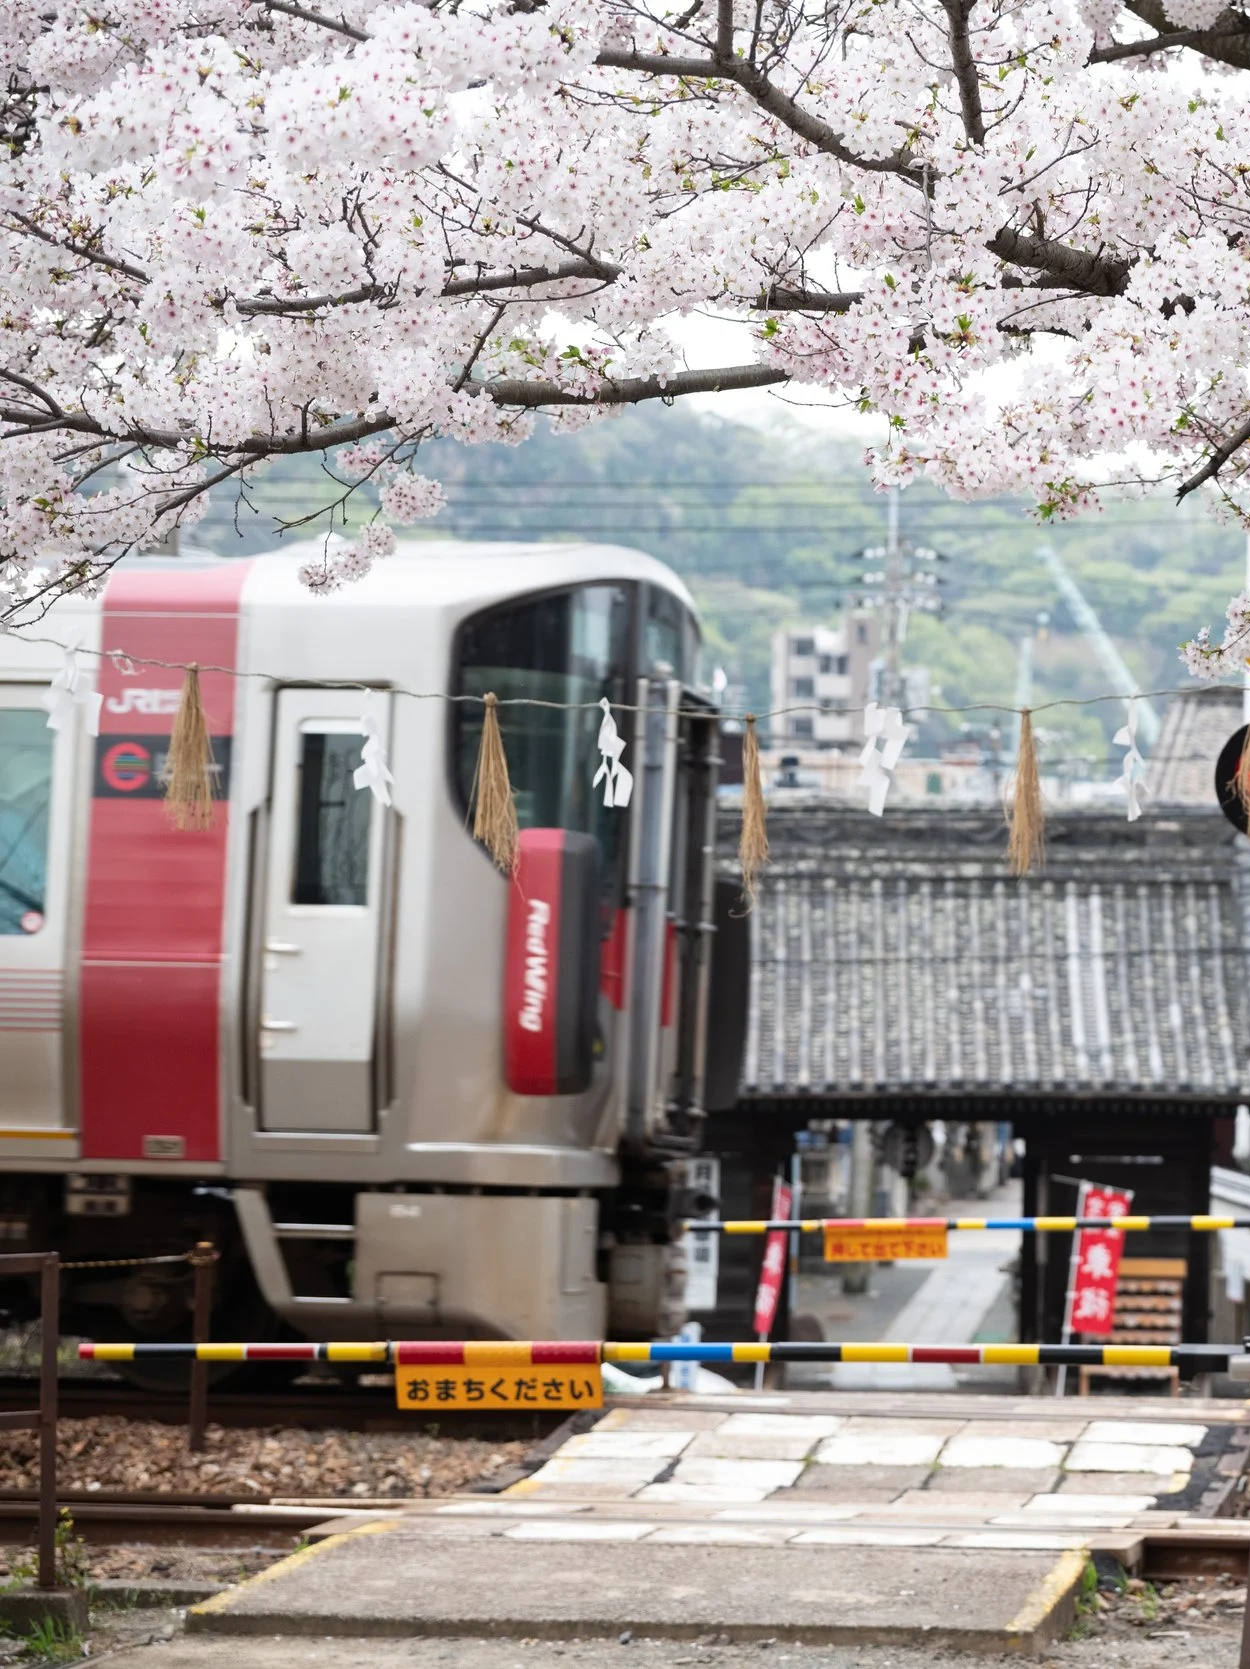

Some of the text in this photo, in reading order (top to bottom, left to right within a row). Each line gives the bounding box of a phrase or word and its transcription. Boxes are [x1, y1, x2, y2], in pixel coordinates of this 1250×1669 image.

[406, 1378, 594, 1402] おまちください
